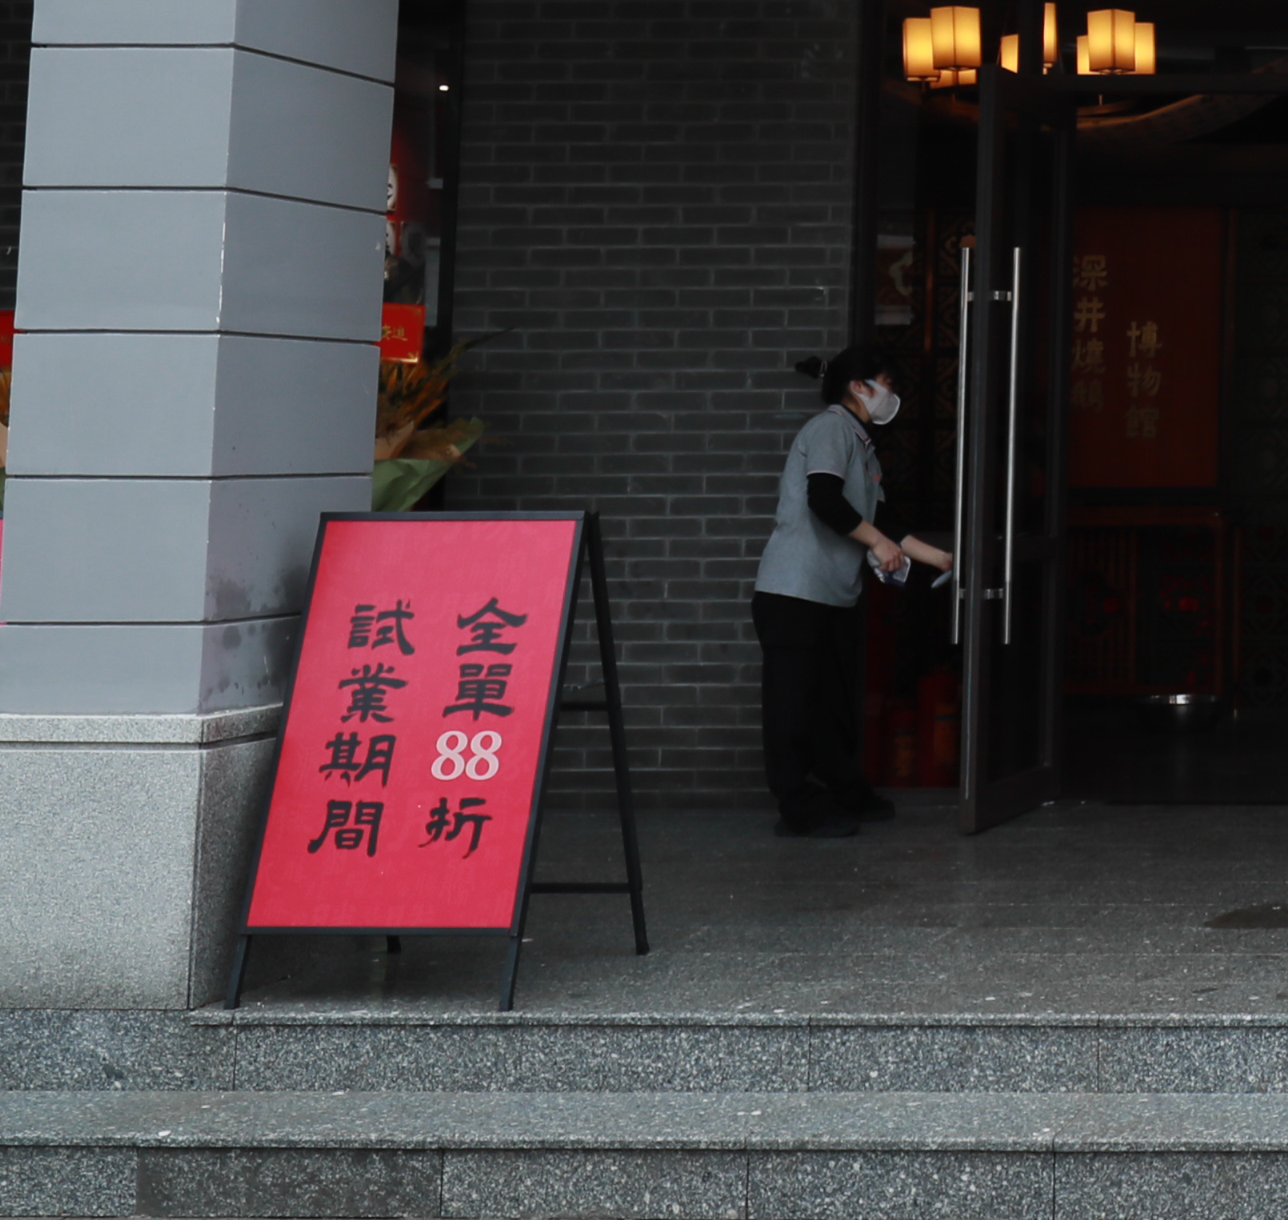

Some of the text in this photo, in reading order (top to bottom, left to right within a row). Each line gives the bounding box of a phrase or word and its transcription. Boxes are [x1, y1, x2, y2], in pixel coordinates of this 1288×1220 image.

[1071, 254, 1108, 412] 深井燒鵝
[1124, 320, 1163, 438] 博物館
[307, 599, 415, 858] 試業期間
[416, 597, 528, 859] 全單88折
